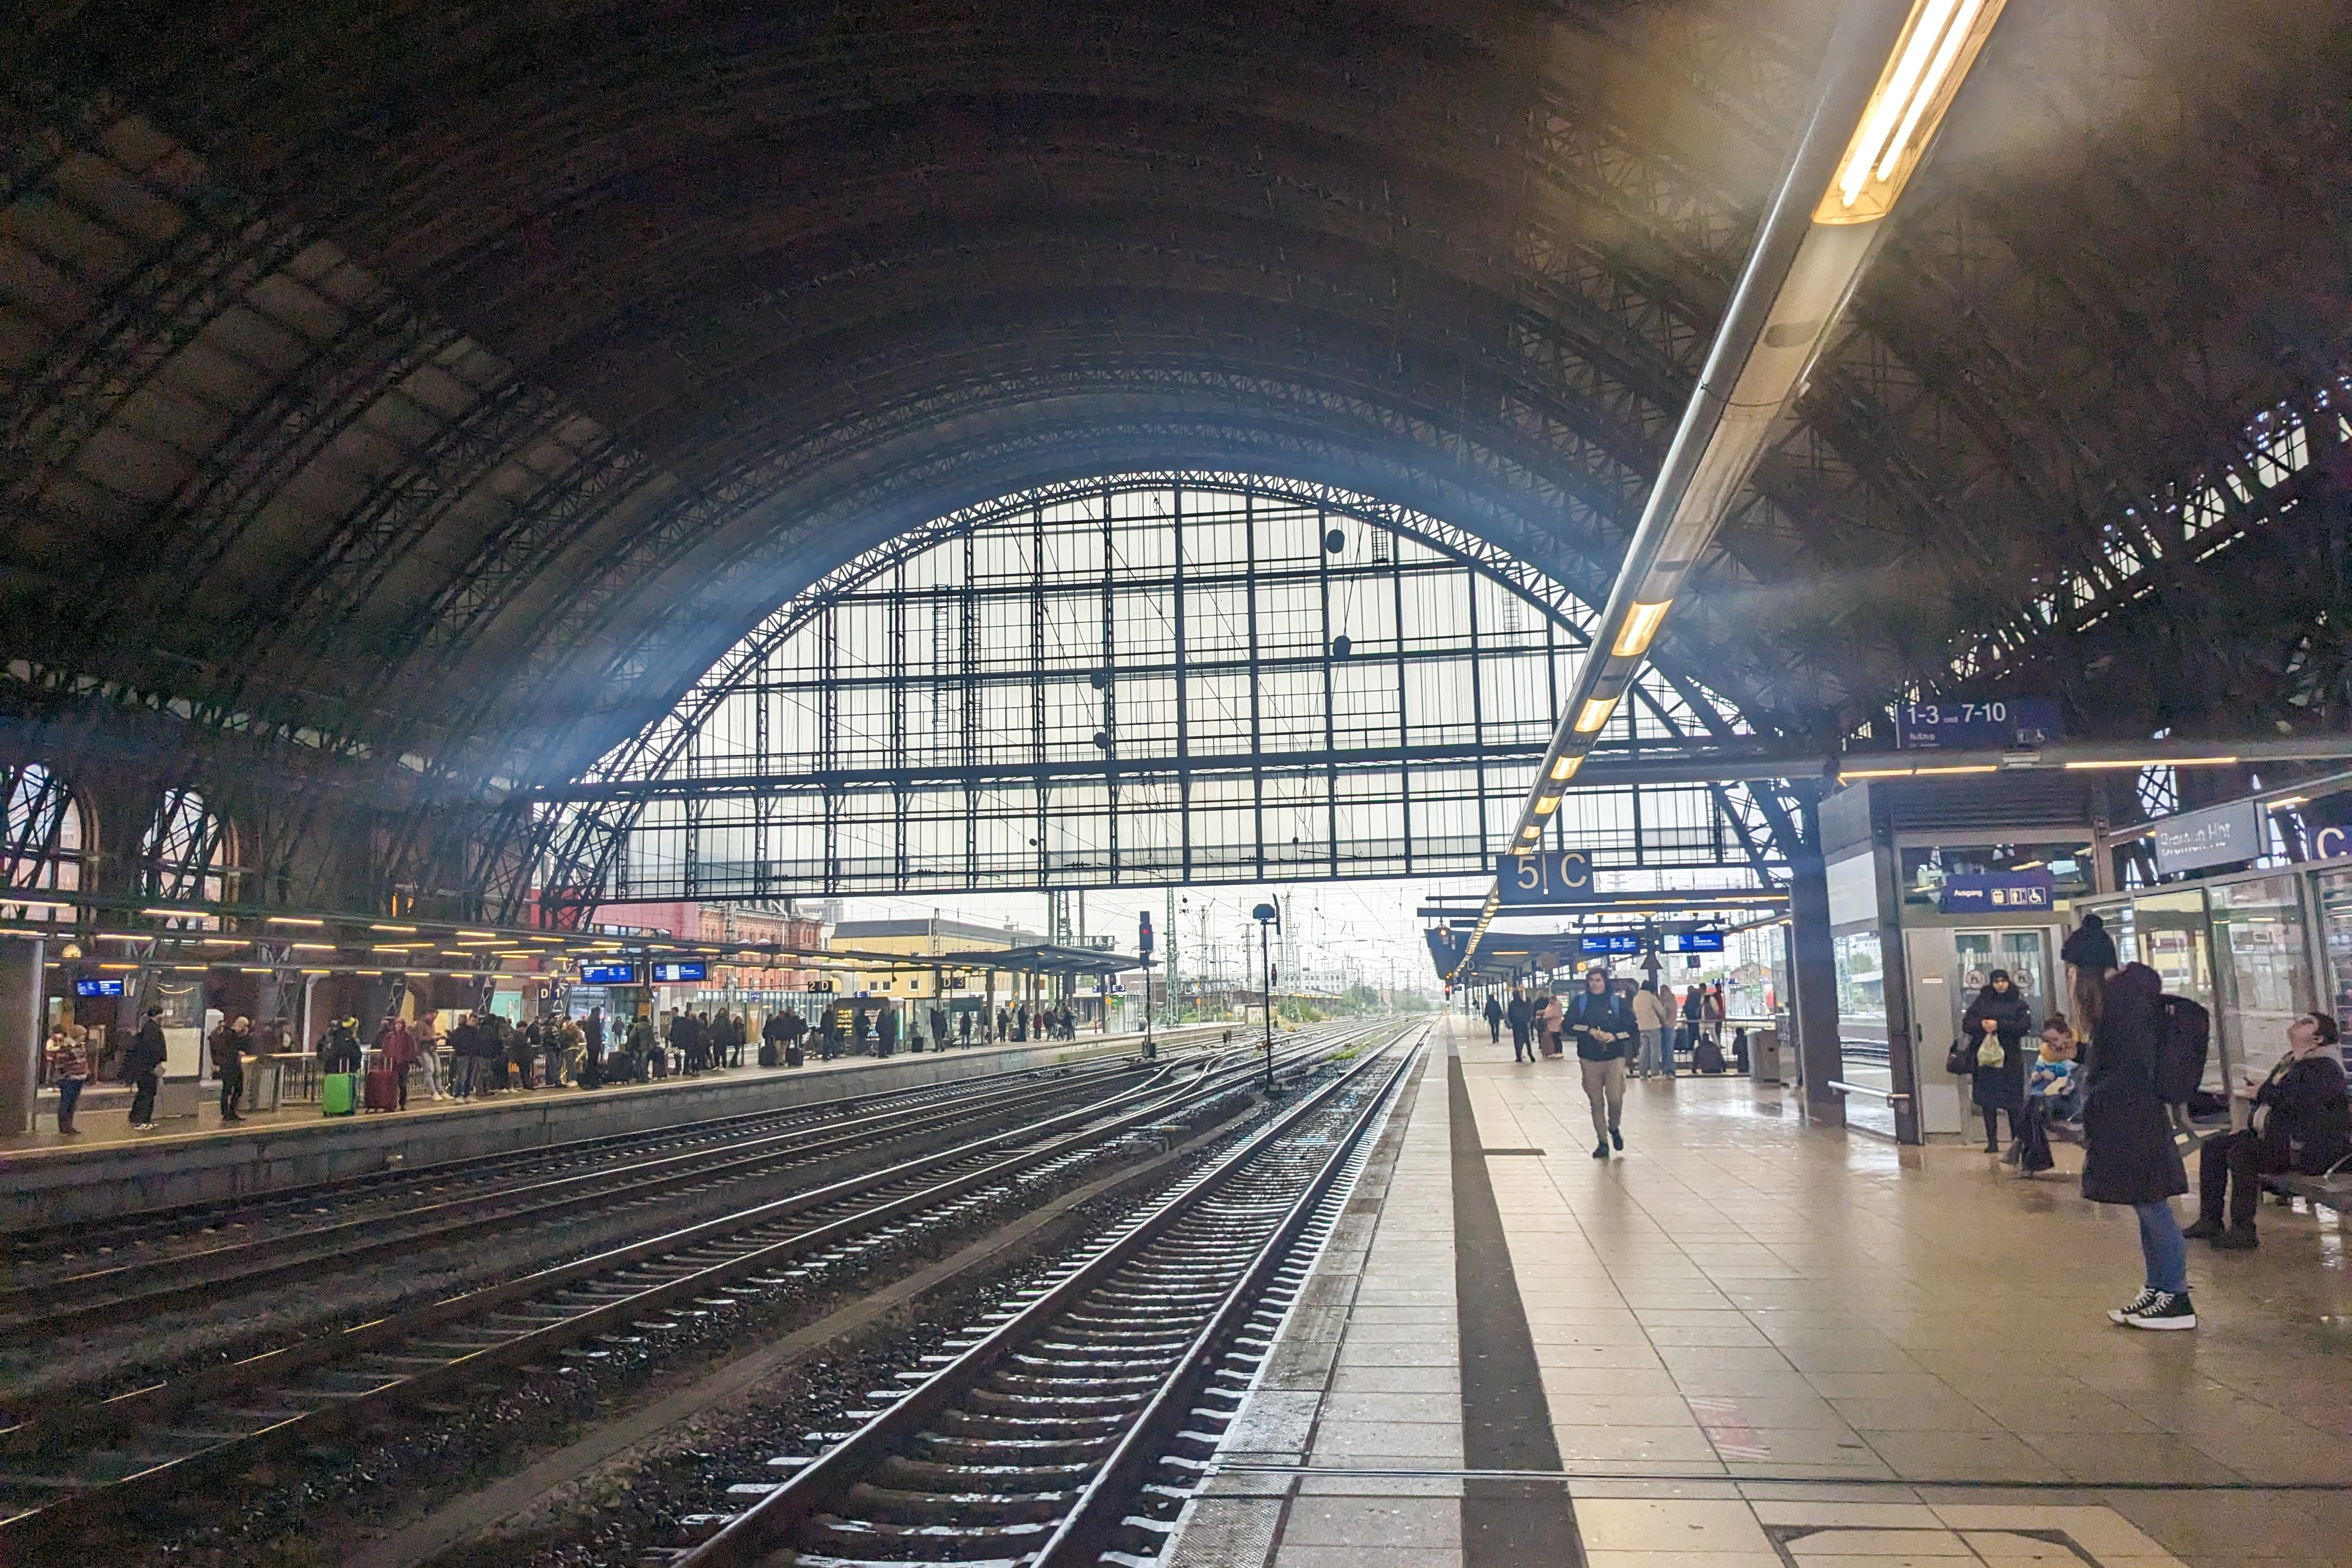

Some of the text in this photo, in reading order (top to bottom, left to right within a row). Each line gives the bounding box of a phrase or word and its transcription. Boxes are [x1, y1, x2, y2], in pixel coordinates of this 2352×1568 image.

[1907, 705, 1940, 725] 1-3
[1961, 702, 2007, 723] 7-10
[2317, 827, 2345, 859] C
[1518, 853, 1587, 889] 5 C
[1467, 960, 1475, 970] D
[808, 981, 829, 991] 2 D
[943, 977, 964, 987] D 3
[541, 989, 560, 998] D 1
